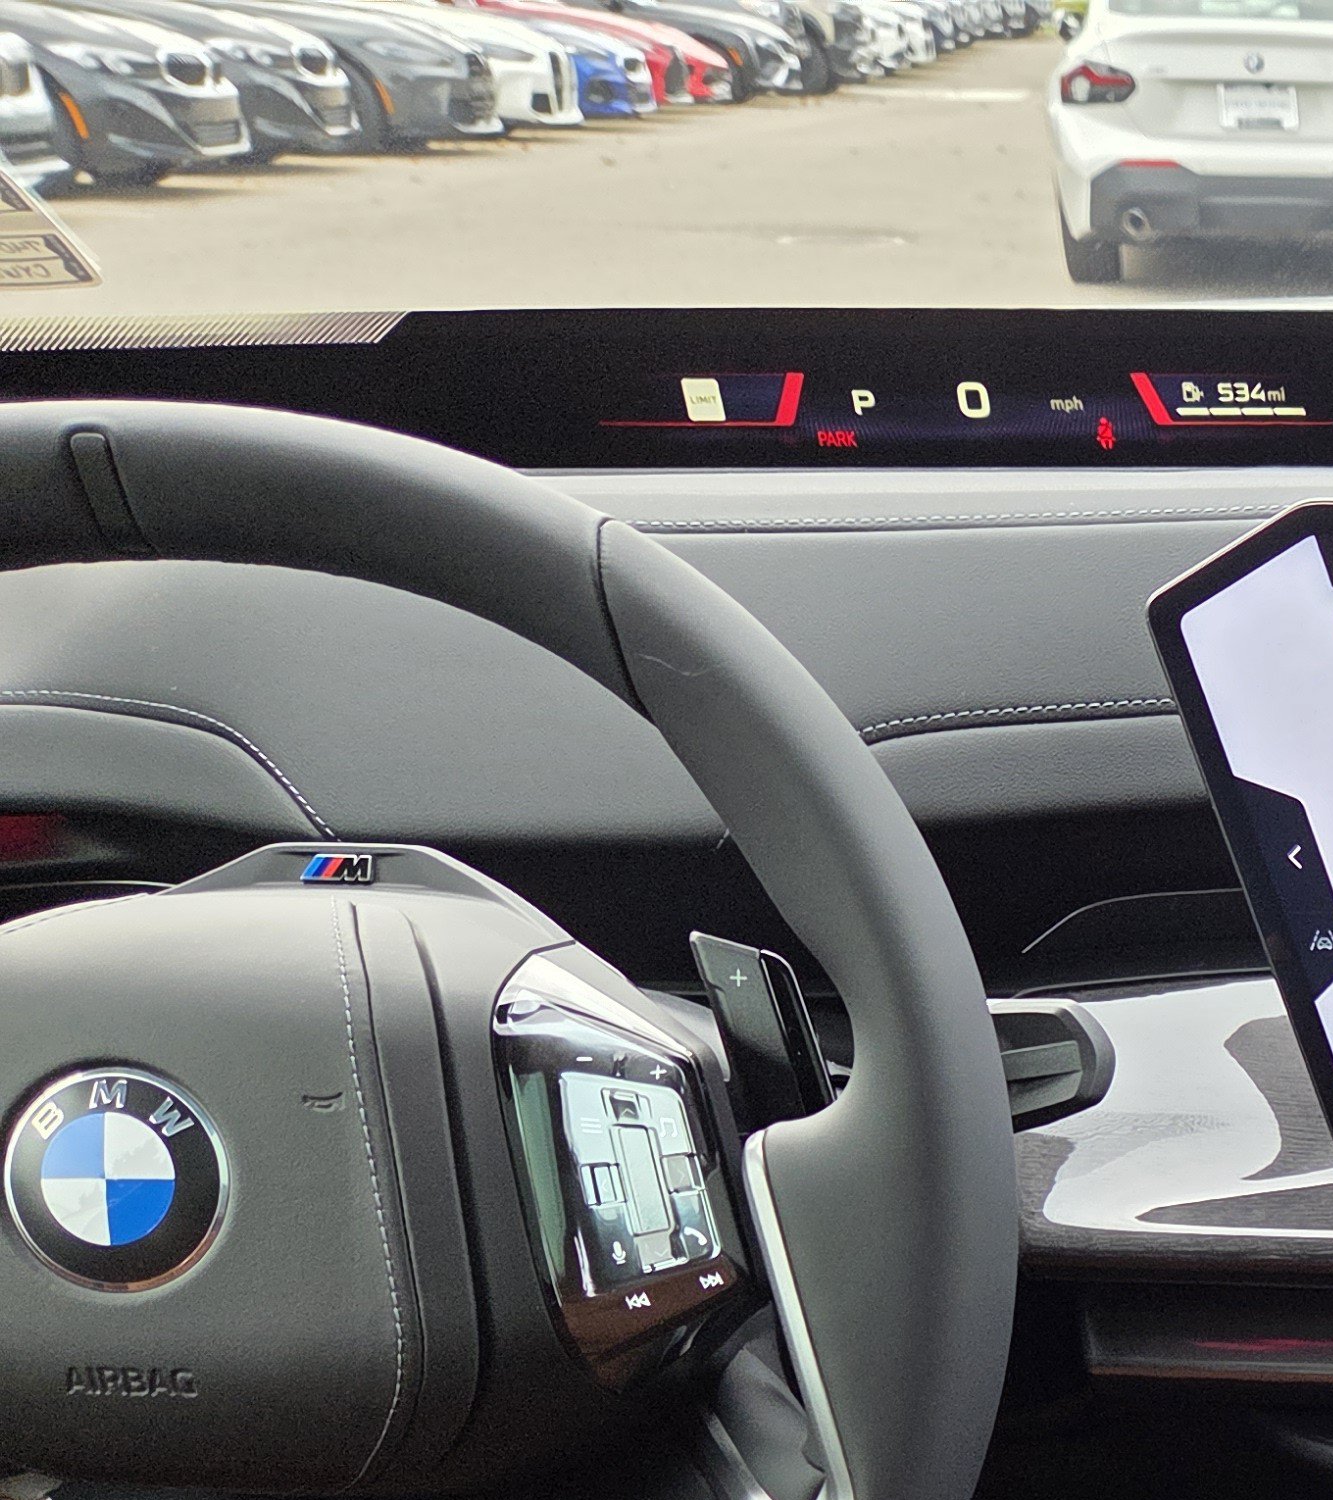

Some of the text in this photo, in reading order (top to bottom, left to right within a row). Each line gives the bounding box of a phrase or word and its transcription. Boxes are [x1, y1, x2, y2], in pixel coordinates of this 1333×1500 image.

[851, 389, 876, 415] P
[1050, 395, 1084, 414] mph
[817, 430, 858, 448] PARK
[64, 1365, 199, 1399] AIRBAG
